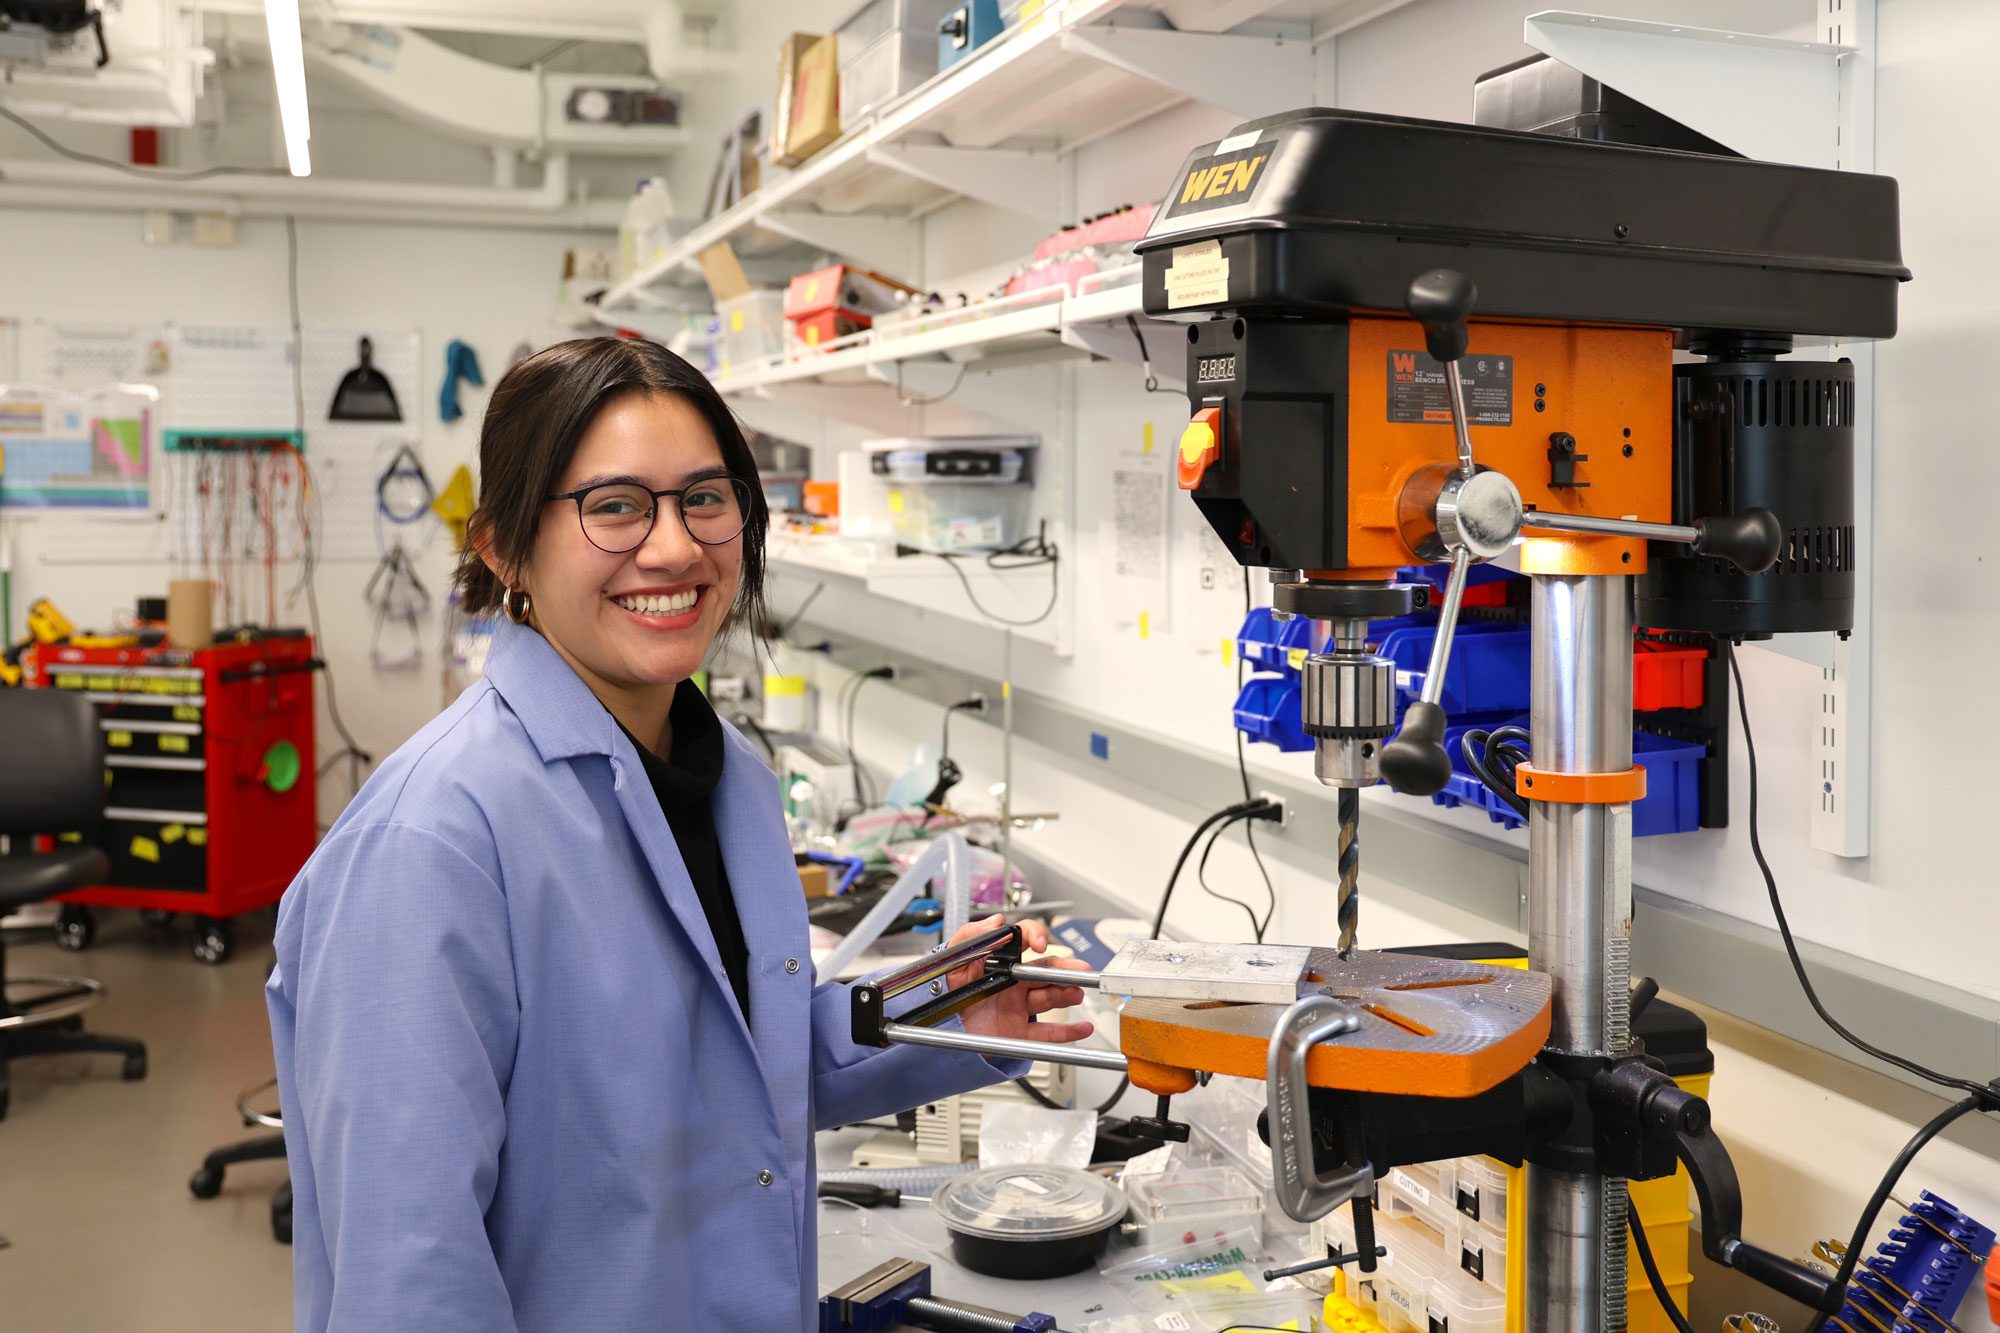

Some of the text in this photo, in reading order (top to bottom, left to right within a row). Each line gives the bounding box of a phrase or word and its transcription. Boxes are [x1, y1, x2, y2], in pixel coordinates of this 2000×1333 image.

[1180, 156, 1262, 204] WEN
[1415, 377, 1436, 385] BENCH
[1399, 1175, 1423, 1198] CUTTING
[1390, 1288, 1410, 1312] POLISH
